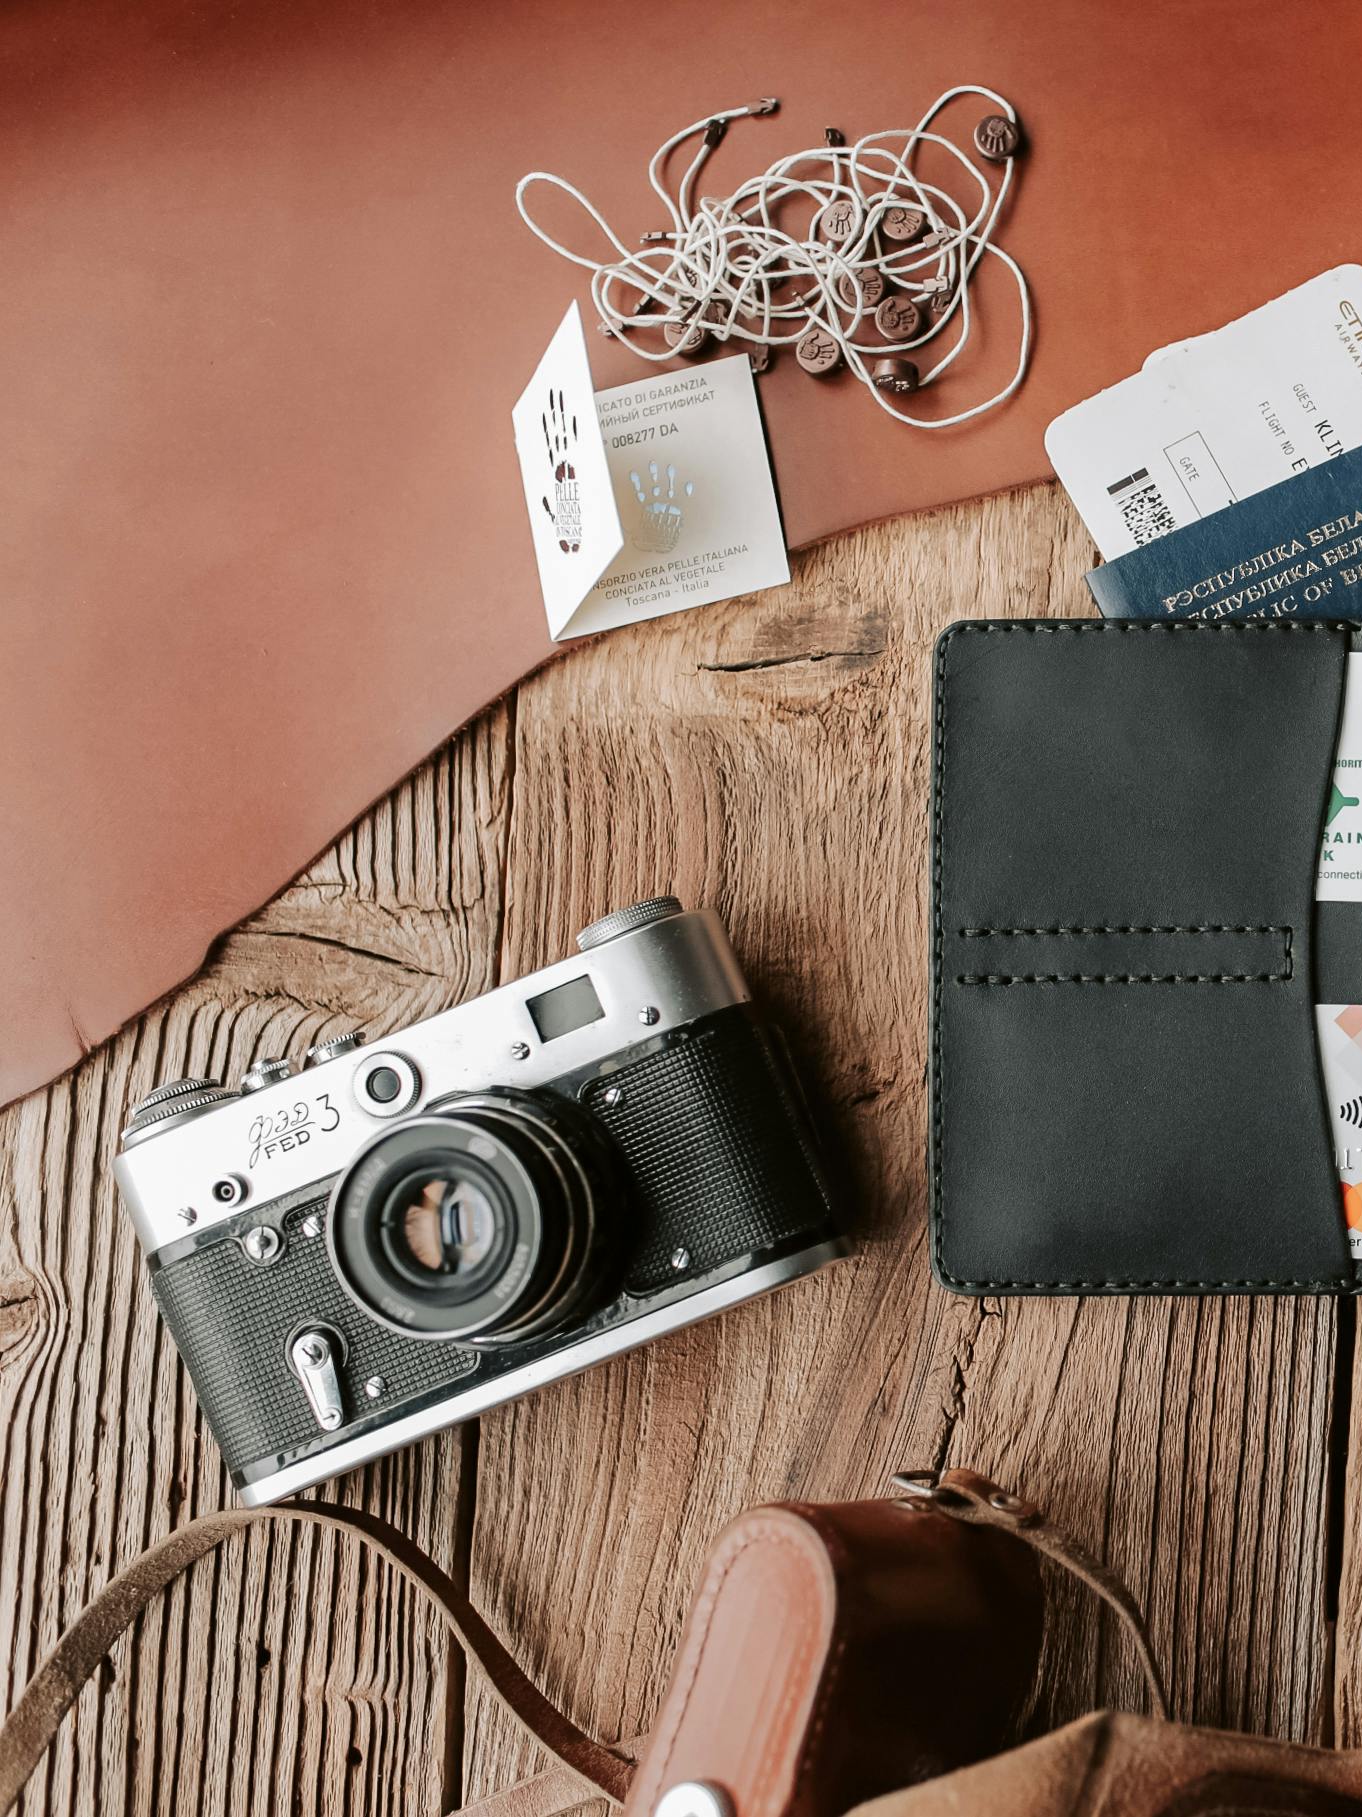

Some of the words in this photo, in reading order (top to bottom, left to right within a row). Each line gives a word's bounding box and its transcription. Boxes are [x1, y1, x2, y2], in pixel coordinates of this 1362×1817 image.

[598, 397, 632, 413] ICATO
[635, 393, 647, 404] DI
[649, 377, 708, 400] GARANZIA
[599, 410, 640, 429] ИЙНЫЙ
[642, 390, 715, 417] СЕРТИФИКАТ
[1292, 383, 1317, 413] GUEST
[611, 427, 655, 449] 008277
[659, 422, 679, 437] DA
[1258, 400, 1286, 437] FLIGHT
[1280, 440, 1295, 456] NO
[1291, 457, 1310, 471] E
[1179, 456, 1200, 482] GATE
[592, 573, 637, 591] NSORZIO
[638, 566, 665, 579] VERA
[667, 557, 700, 571] PELLE
[702, 544, 749, 563] ITALIANA
[605, 581, 657, 600] CONCIATA
[659, 577, 673, 586] AL
[673, 562, 726, 583] VEGETALE
[1162, 539, 1307, 613] РЭСПУБЛІКА
[625, 590, 671, 607] Toscana
[682, 579, 710, 593] Italia
[1188, 560, 1322, 619] СПУБЛИКА
[1303, 578, 1333, 602] OF
[315, 1093, 340, 1132] 3
[264, 1130, 311, 1160] FED
